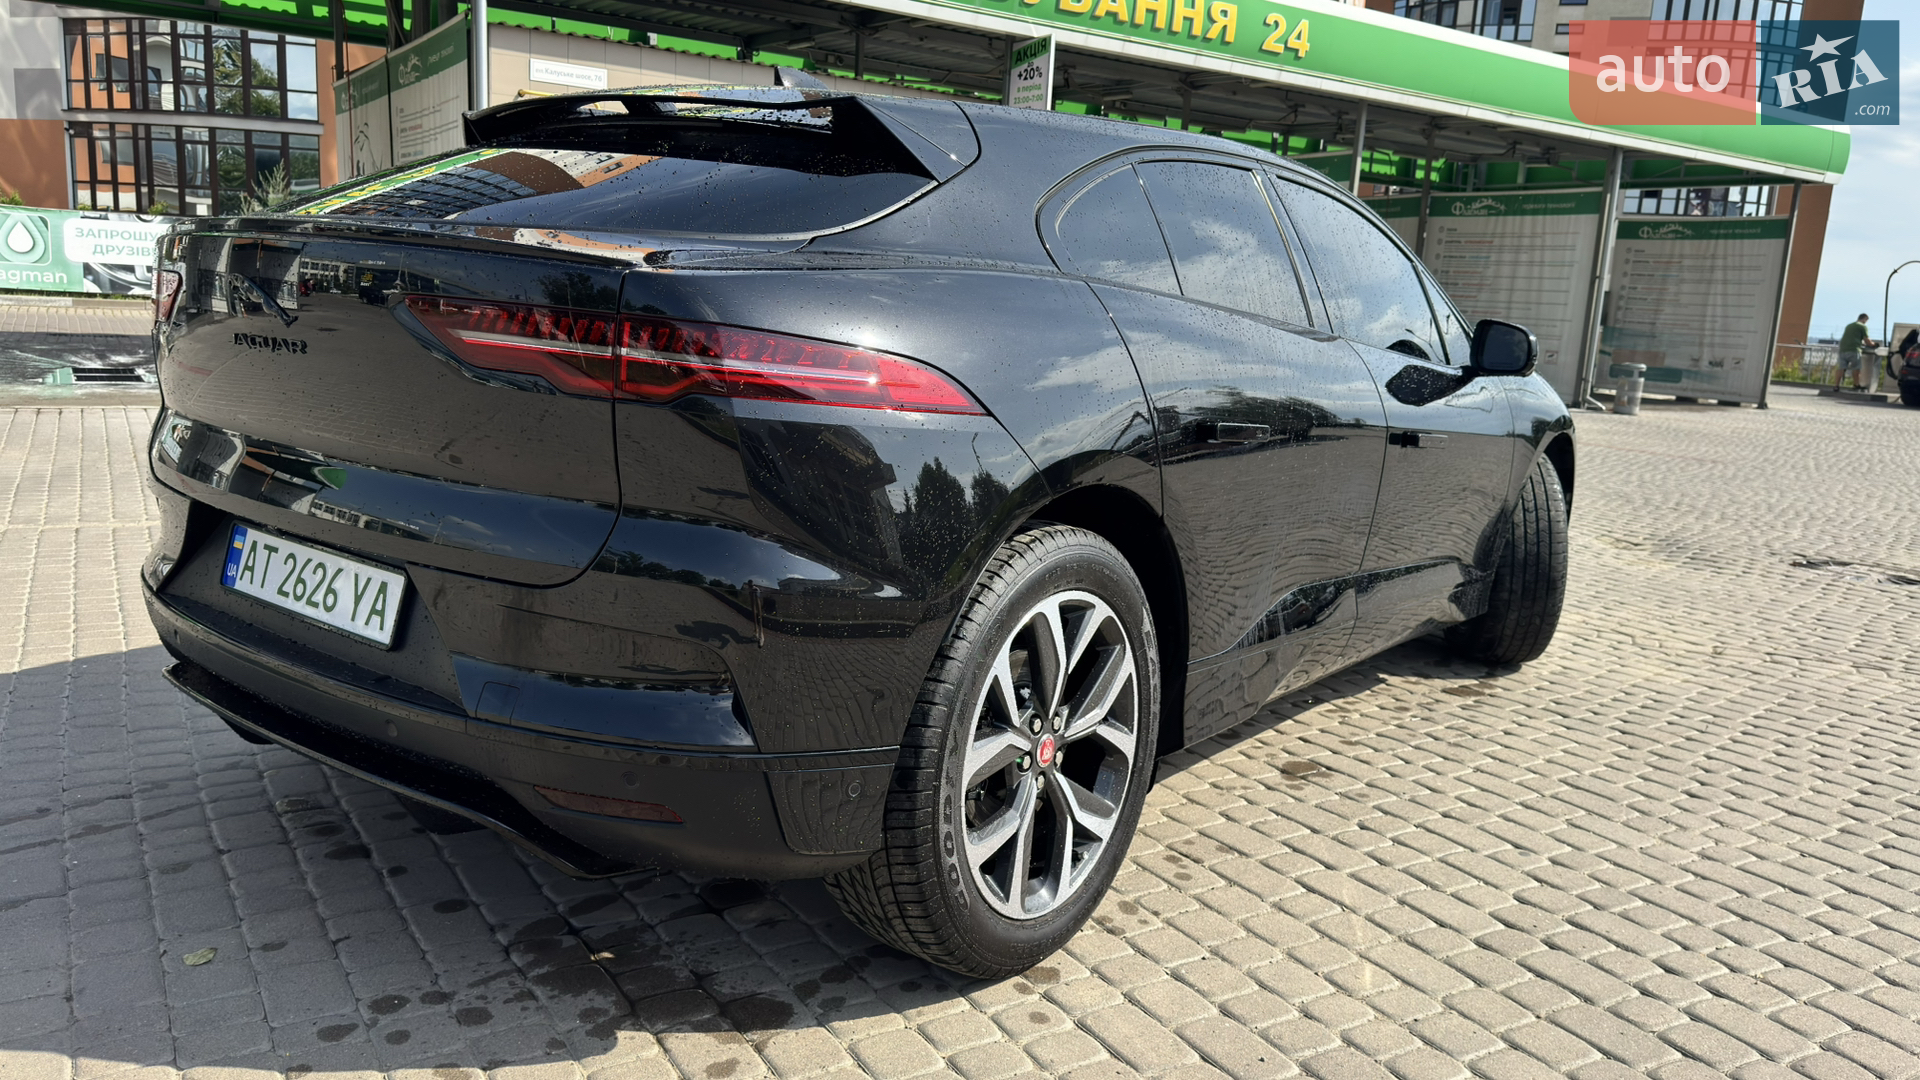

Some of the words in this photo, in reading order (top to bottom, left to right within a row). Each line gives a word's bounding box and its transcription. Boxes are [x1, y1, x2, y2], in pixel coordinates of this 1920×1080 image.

[1022, 0, 1238, 43] АННЯ
[1262, 13, 1310, 58] 24
[1015, 37, 1047, 65] АКЦІЯ
[544, 67, 574, 78] Калуське
[1017, 66, 1043, 81] +20%
[1022, 83, 1042, 93] період
[75, 227, 159, 242] ЗАПРОШУ
[0, 269, 68, 284] agman
[227, 562, 237, 578] UA
[239, 539, 280, 589] AT
[276, 552, 344, 613] 2626
[350, 572, 389, 632] YA
